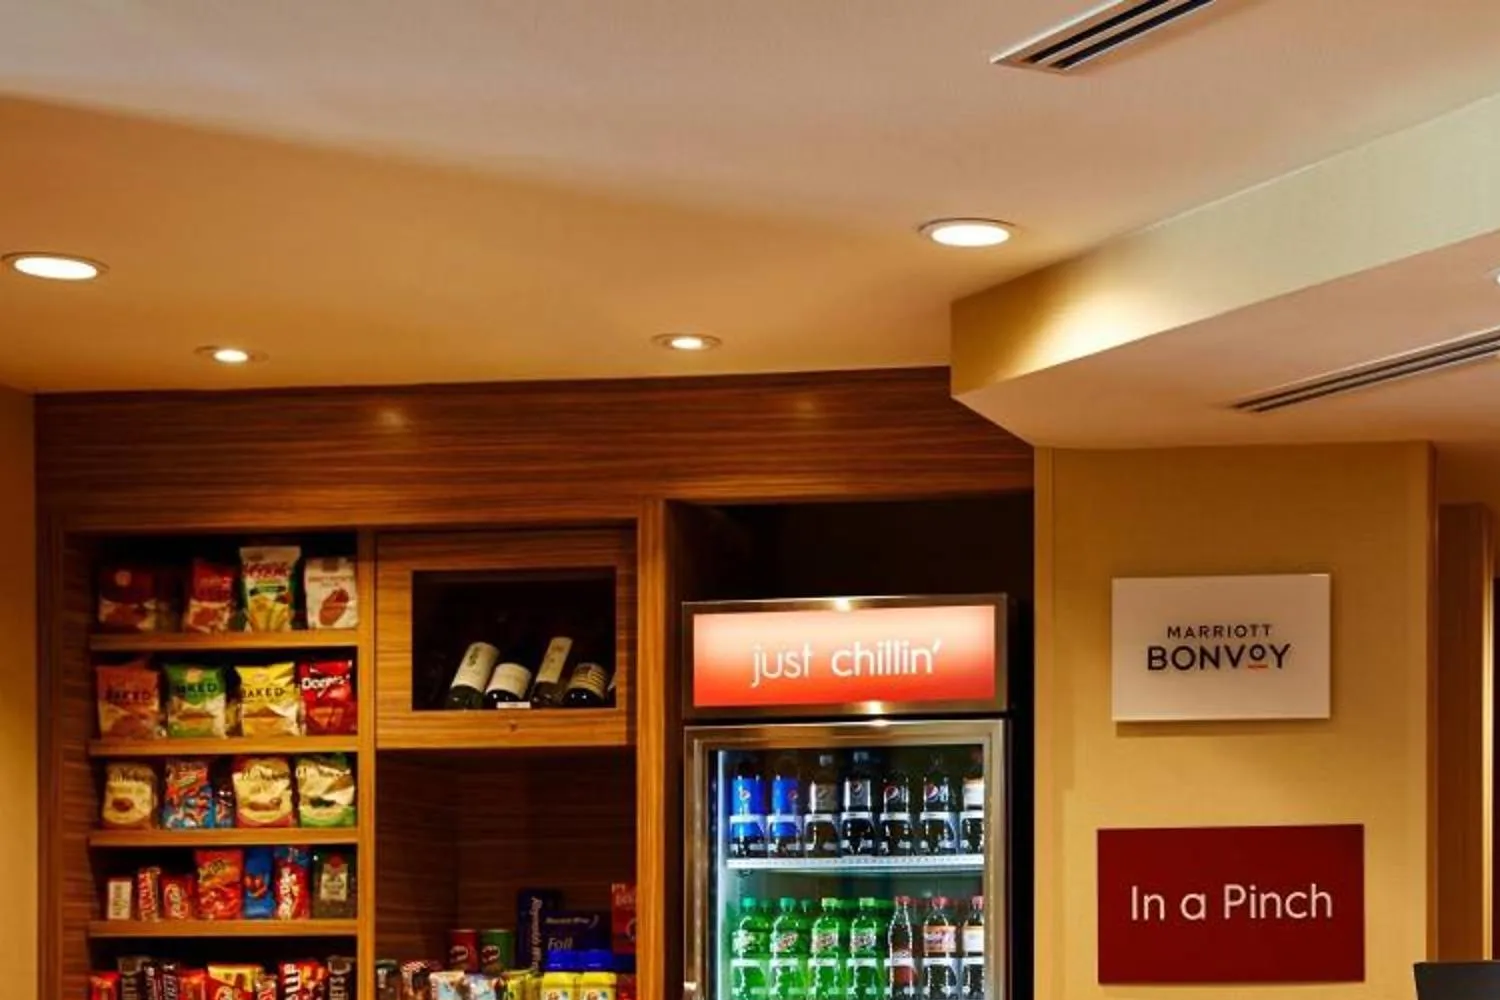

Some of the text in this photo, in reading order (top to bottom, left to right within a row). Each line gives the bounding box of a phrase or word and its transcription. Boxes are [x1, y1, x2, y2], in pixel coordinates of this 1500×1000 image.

[1167, 623, 1273, 640] MARRIOTT
[751, 638, 941, 687] just chillin'
[1147, 643, 1290, 671] BONVOY
[1131, 883, 1333, 920] In a Pinch
